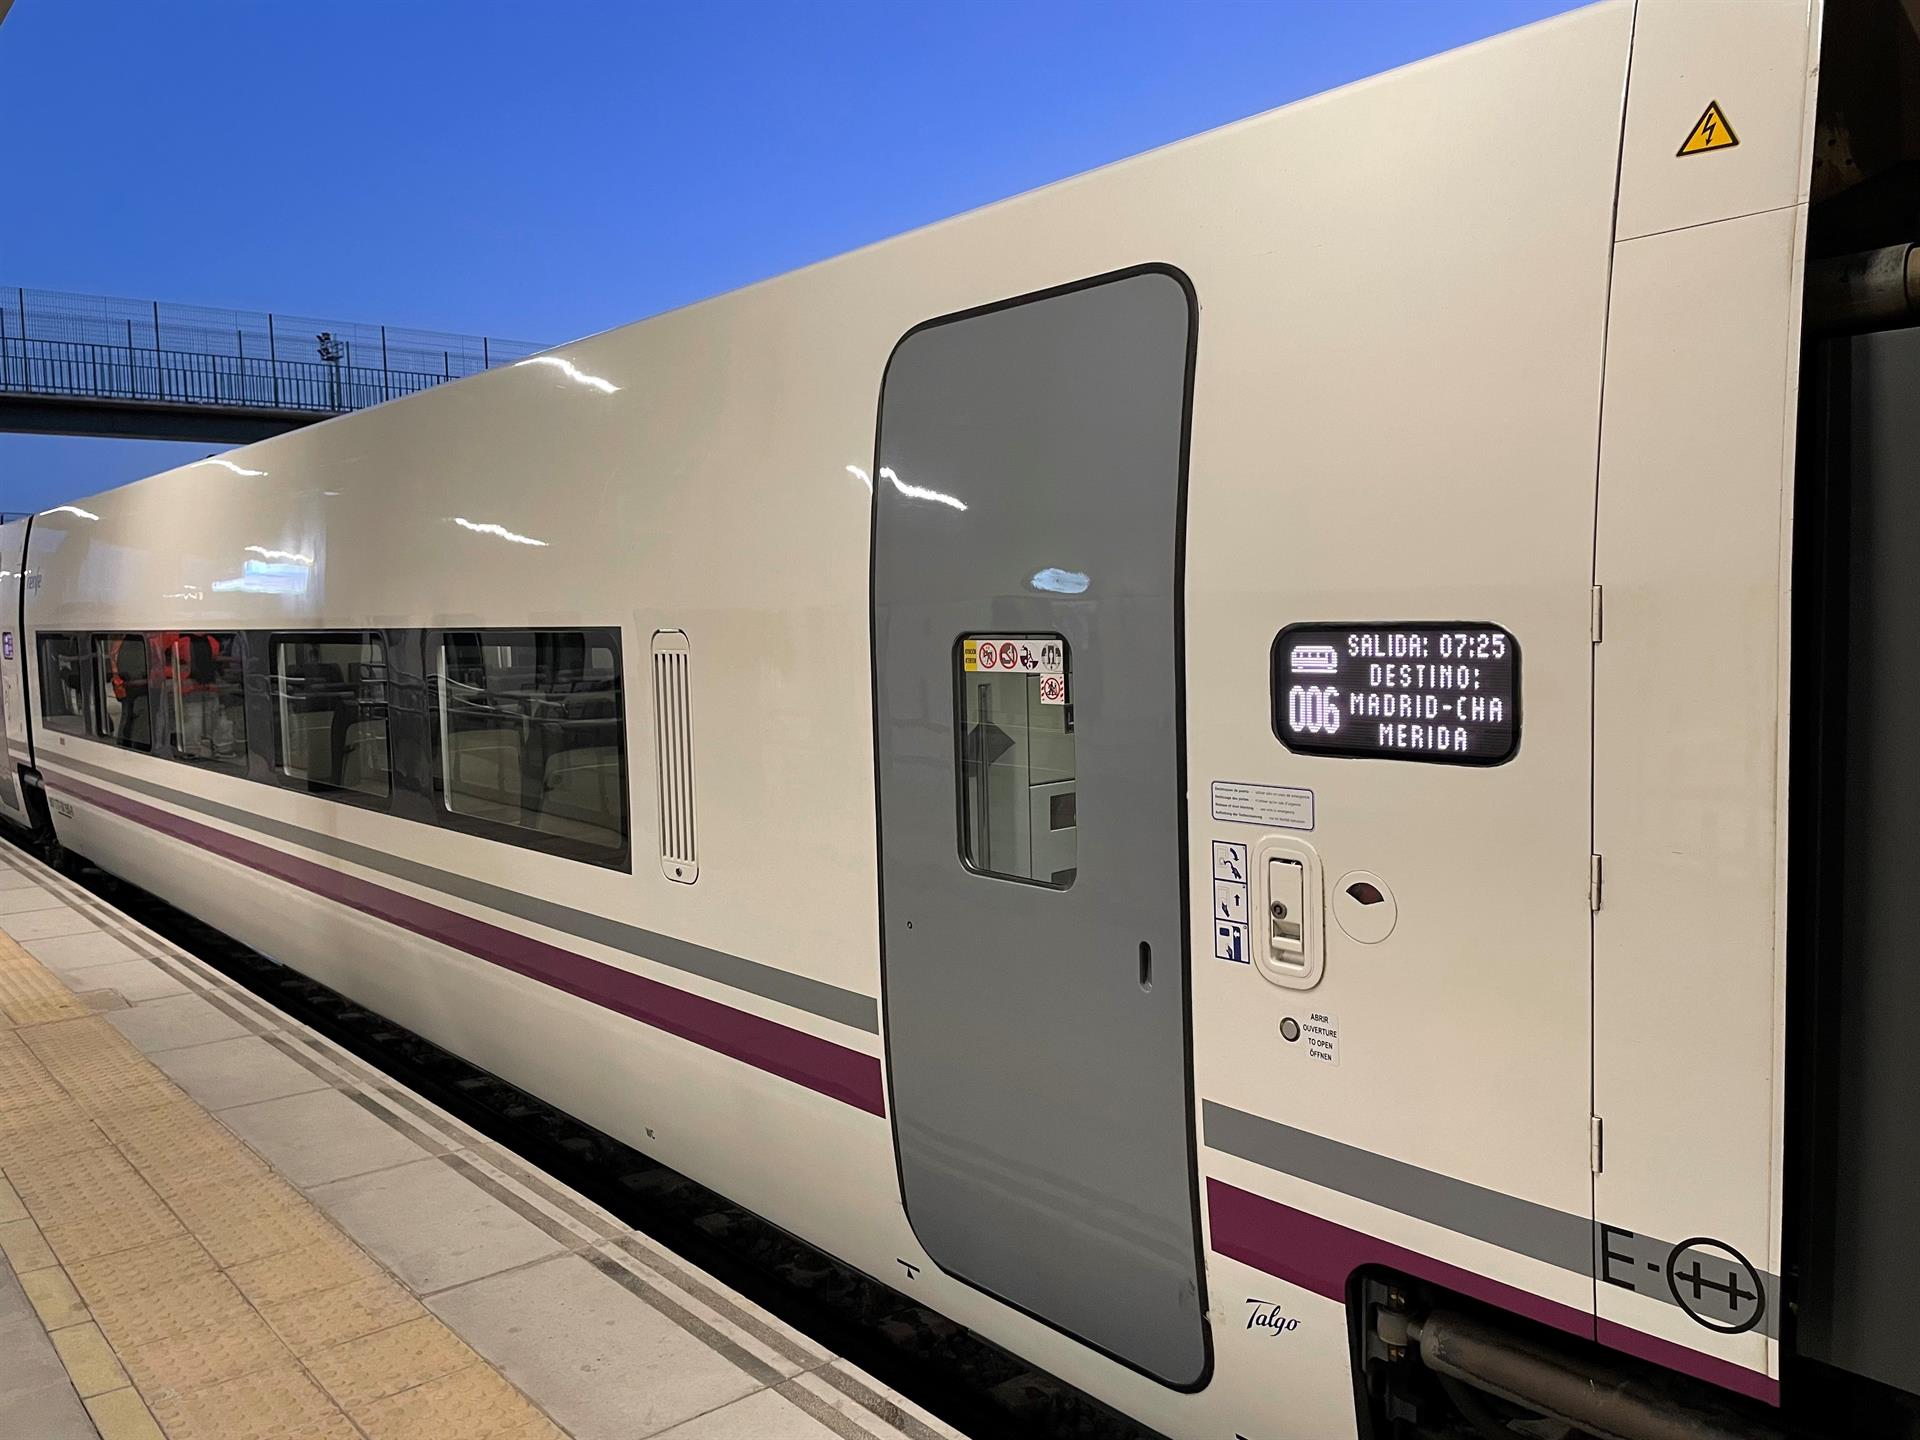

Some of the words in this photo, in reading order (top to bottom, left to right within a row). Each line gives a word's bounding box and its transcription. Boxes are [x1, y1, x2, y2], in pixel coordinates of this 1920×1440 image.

[1348, 633, 1429, 658] SALIDA:
[1439, 633, 1506, 659] 07:25
[1370, 663, 1480, 690] DESTINO:
[1289, 685, 1340, 734] 006
[1350, 692, 1503, 722] MADRID-CHA
[1379, 723, 1467, 751] MERIDA
[1302, 1024, 1338, 1038] OUVERTURE
[1310, 1013, 1329, 1024] ABRIR
[1308, 1037, 1316, 1046] TO
[1317, 1039, 1333, 1050] OPEN
[1245, 1298, 1302, 1337] Talgo
